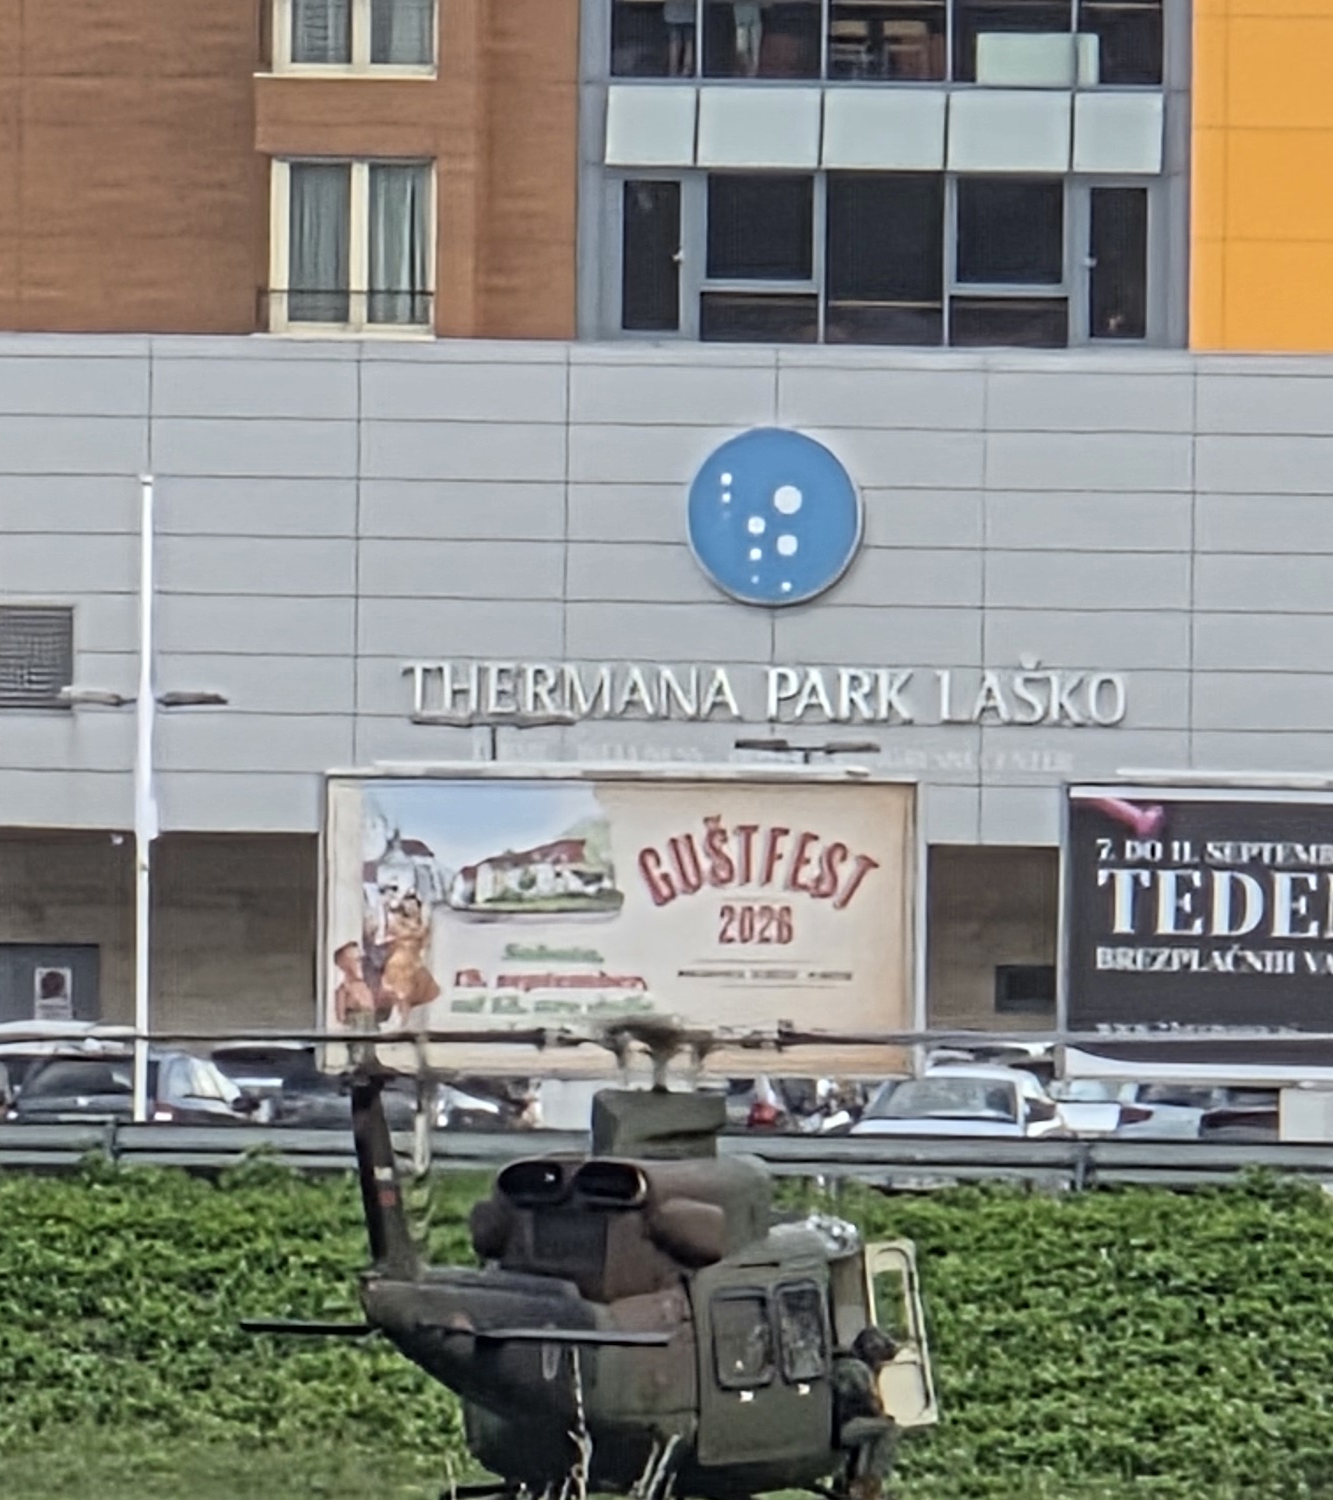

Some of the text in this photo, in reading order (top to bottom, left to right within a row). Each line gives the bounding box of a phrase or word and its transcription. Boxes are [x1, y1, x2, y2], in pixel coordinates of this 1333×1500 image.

[401, 651, 1128, 726] THERMANA PARK LAŠKO
[637, 813, 880, 910] GUŠTFEST
[1124, 840, 1163, 862] DO
[718, 904, 794, 945] 2026
[1097, 867, 1333, 938] TEDE
